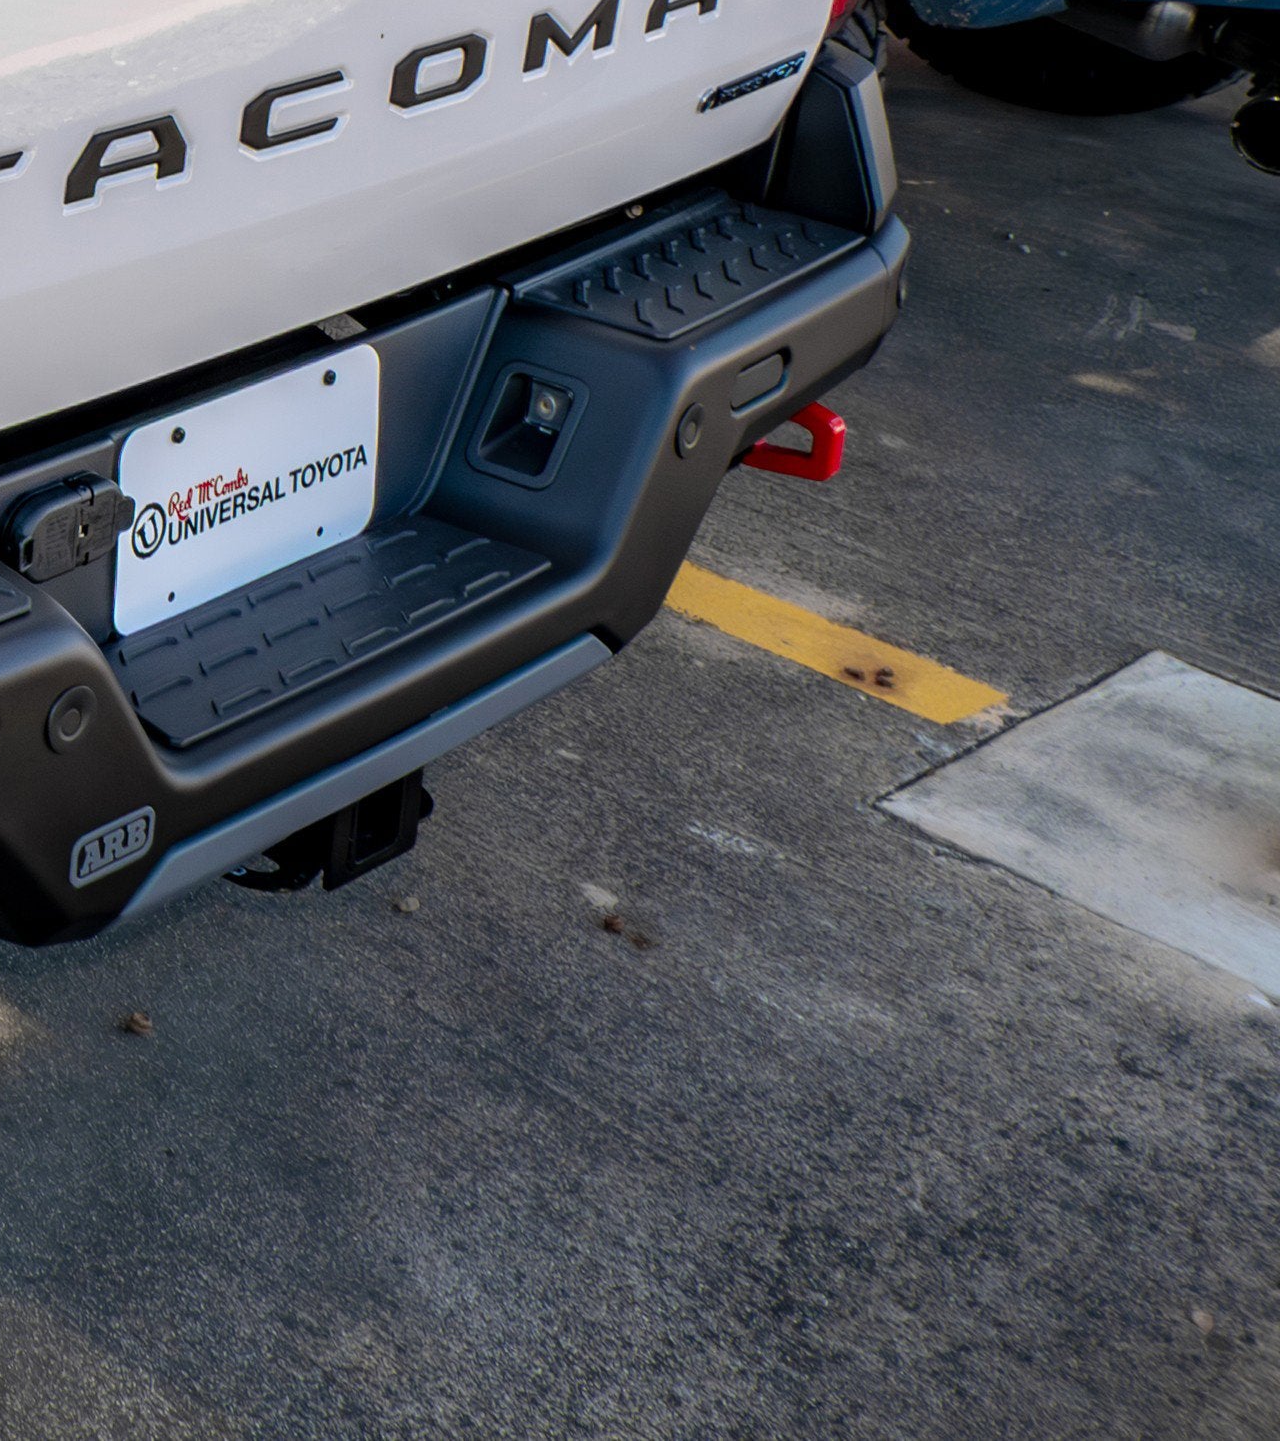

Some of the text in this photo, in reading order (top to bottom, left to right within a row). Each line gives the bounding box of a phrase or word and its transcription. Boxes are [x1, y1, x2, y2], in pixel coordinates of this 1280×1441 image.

[168, 468, 248, 521] Red McCombs
[168, 444, 367, 546] UNIVERSAL TOYOTA
[79, 817, 148, 877] ARB
